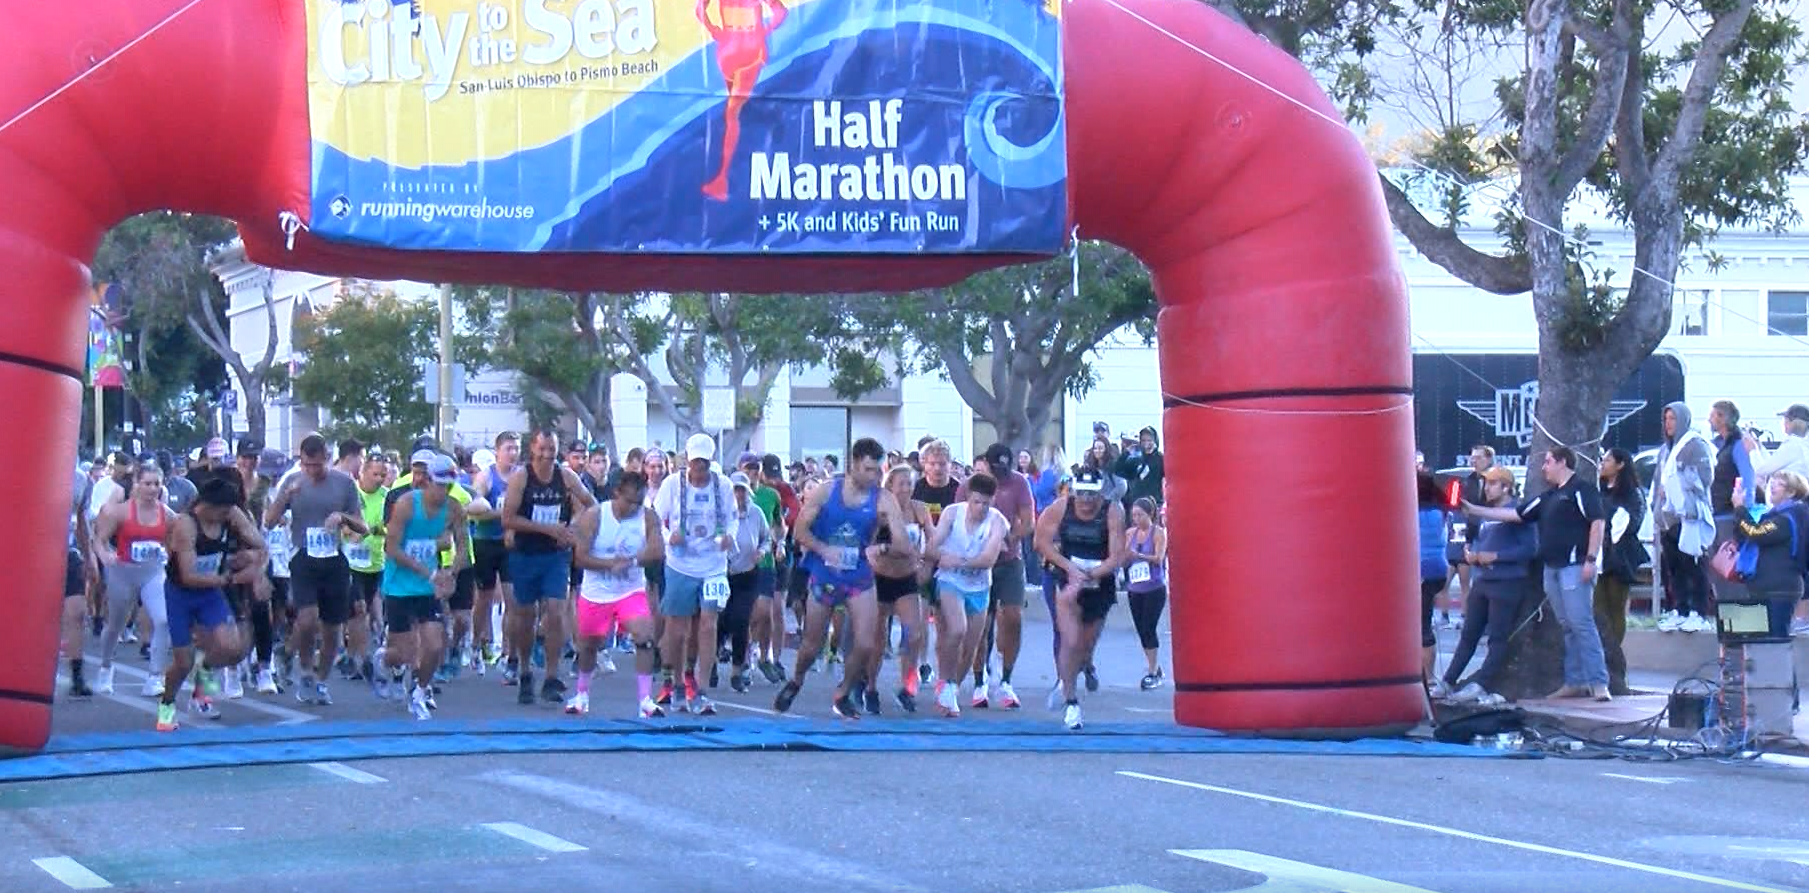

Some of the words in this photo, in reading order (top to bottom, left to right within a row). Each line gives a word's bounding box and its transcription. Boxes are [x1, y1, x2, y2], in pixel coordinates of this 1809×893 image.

[479, 2, 508, 32] to
[522, 0, 658, 64] Sea
[319, 0, 470, 102] City
[469, 36, 517, 66] the
[459, 80, 486, 94] San
[488, 78, 514, 90] Luis
[517, 72, 561, 88] Obispo
[565, 70, 577, 82] to
[580, 66, 618, 80] Pismo
[621, 59, 659, 75] Beach
[813, 98, 903, 149] Half
[750, 152, 966, 201] Marathon
[361, 196, 535, 222] runningwarehouse
[777, 212, 799, 232] 5K
[804, 212, 837, 232] and
[890, 212, 921, 232] Fun
[927, 213, 959, 232] Run
